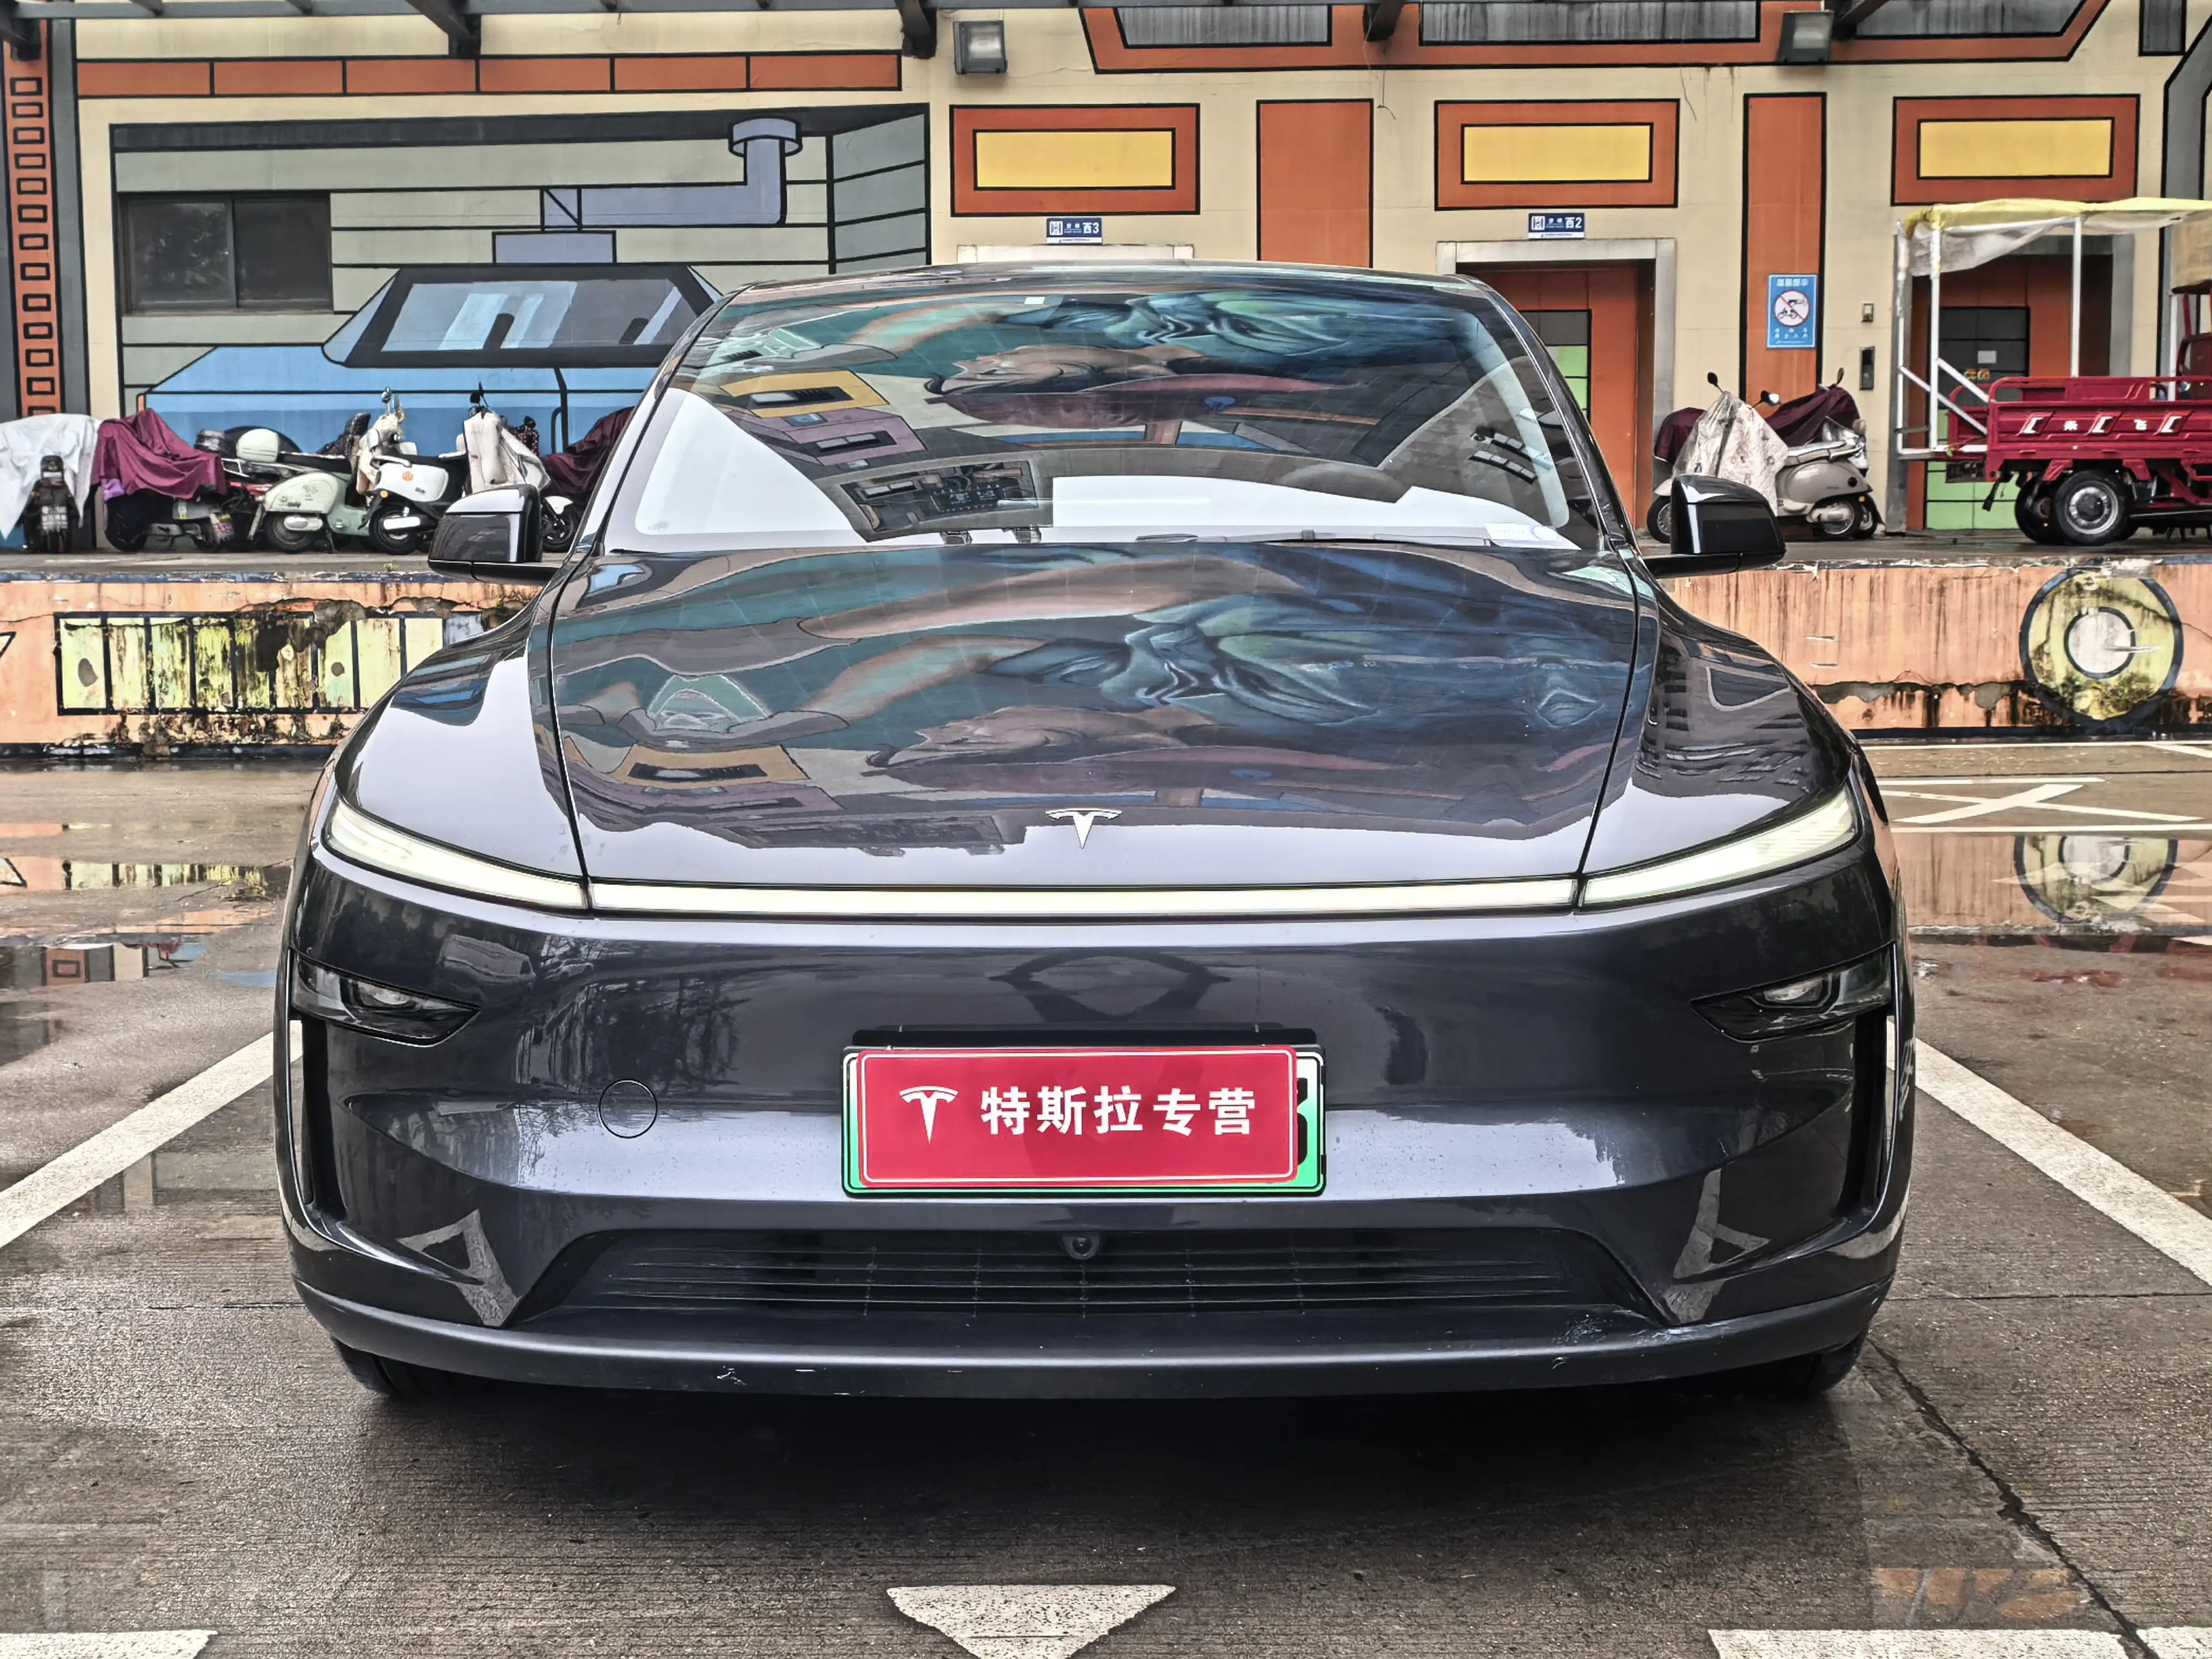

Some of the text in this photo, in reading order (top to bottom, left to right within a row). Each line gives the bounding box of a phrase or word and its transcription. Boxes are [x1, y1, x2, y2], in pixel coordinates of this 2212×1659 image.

[981, 1085, 1256, 1137] 特斯拉专营
